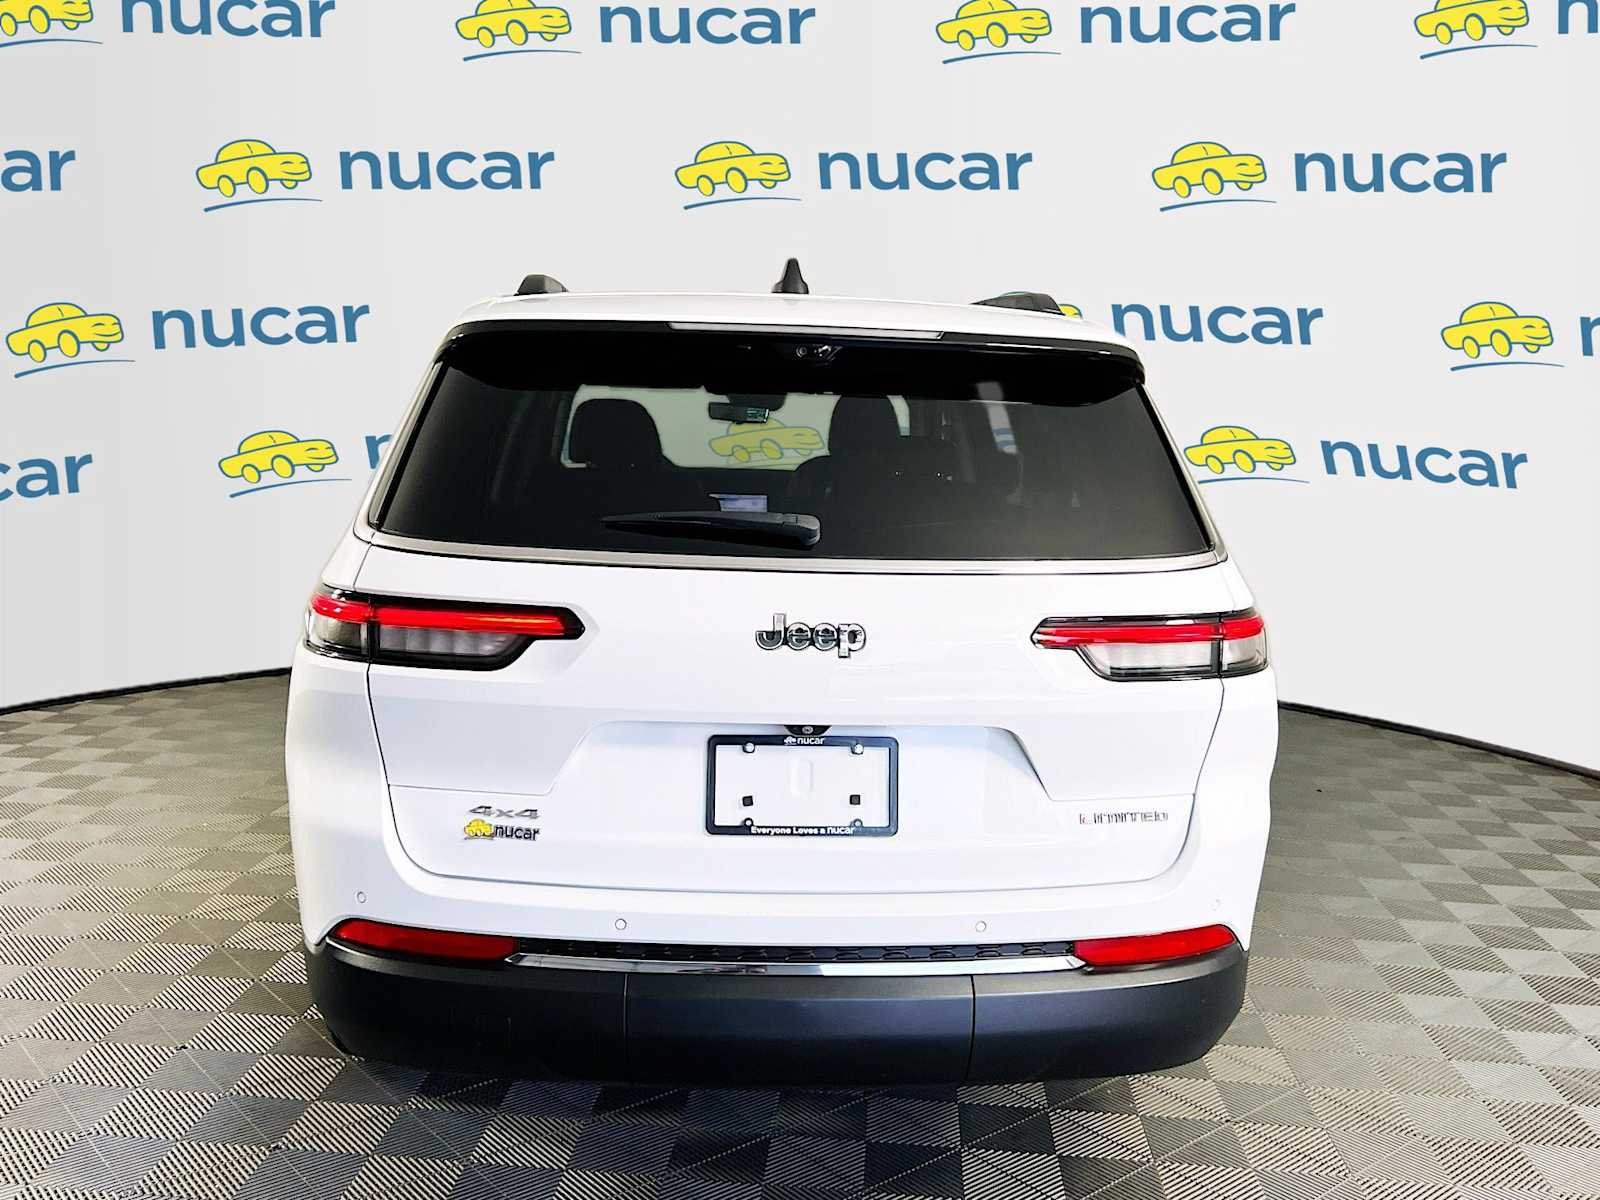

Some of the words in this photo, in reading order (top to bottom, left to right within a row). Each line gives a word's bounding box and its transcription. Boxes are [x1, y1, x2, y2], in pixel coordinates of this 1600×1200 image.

[121, 0, 337, 39] nucar
[598, 5, 816, 46] nucar
[1079, 2, 1297, 45] nucar
[338, 150, 557, 192] nucar
[818, 151, 1034, 192] nucar
[1294, 152, 1508, 194] nucar
[150, 303, 369, 351] nucar
[1110, 303, 1324, 347] nucar
[1319, 439, 1528, 490] nucar
[755, 612, 867, 659] Jeep
[796, 734, 826, 746] nucar
[494, 824, 540, 841] nucar
[751, 826, 792, 836] Everyone
[793, 826, 819, 835] Loves
[827, 825, 855, 835] nucar
[1079, 809, 1169, 825] LIMITED
